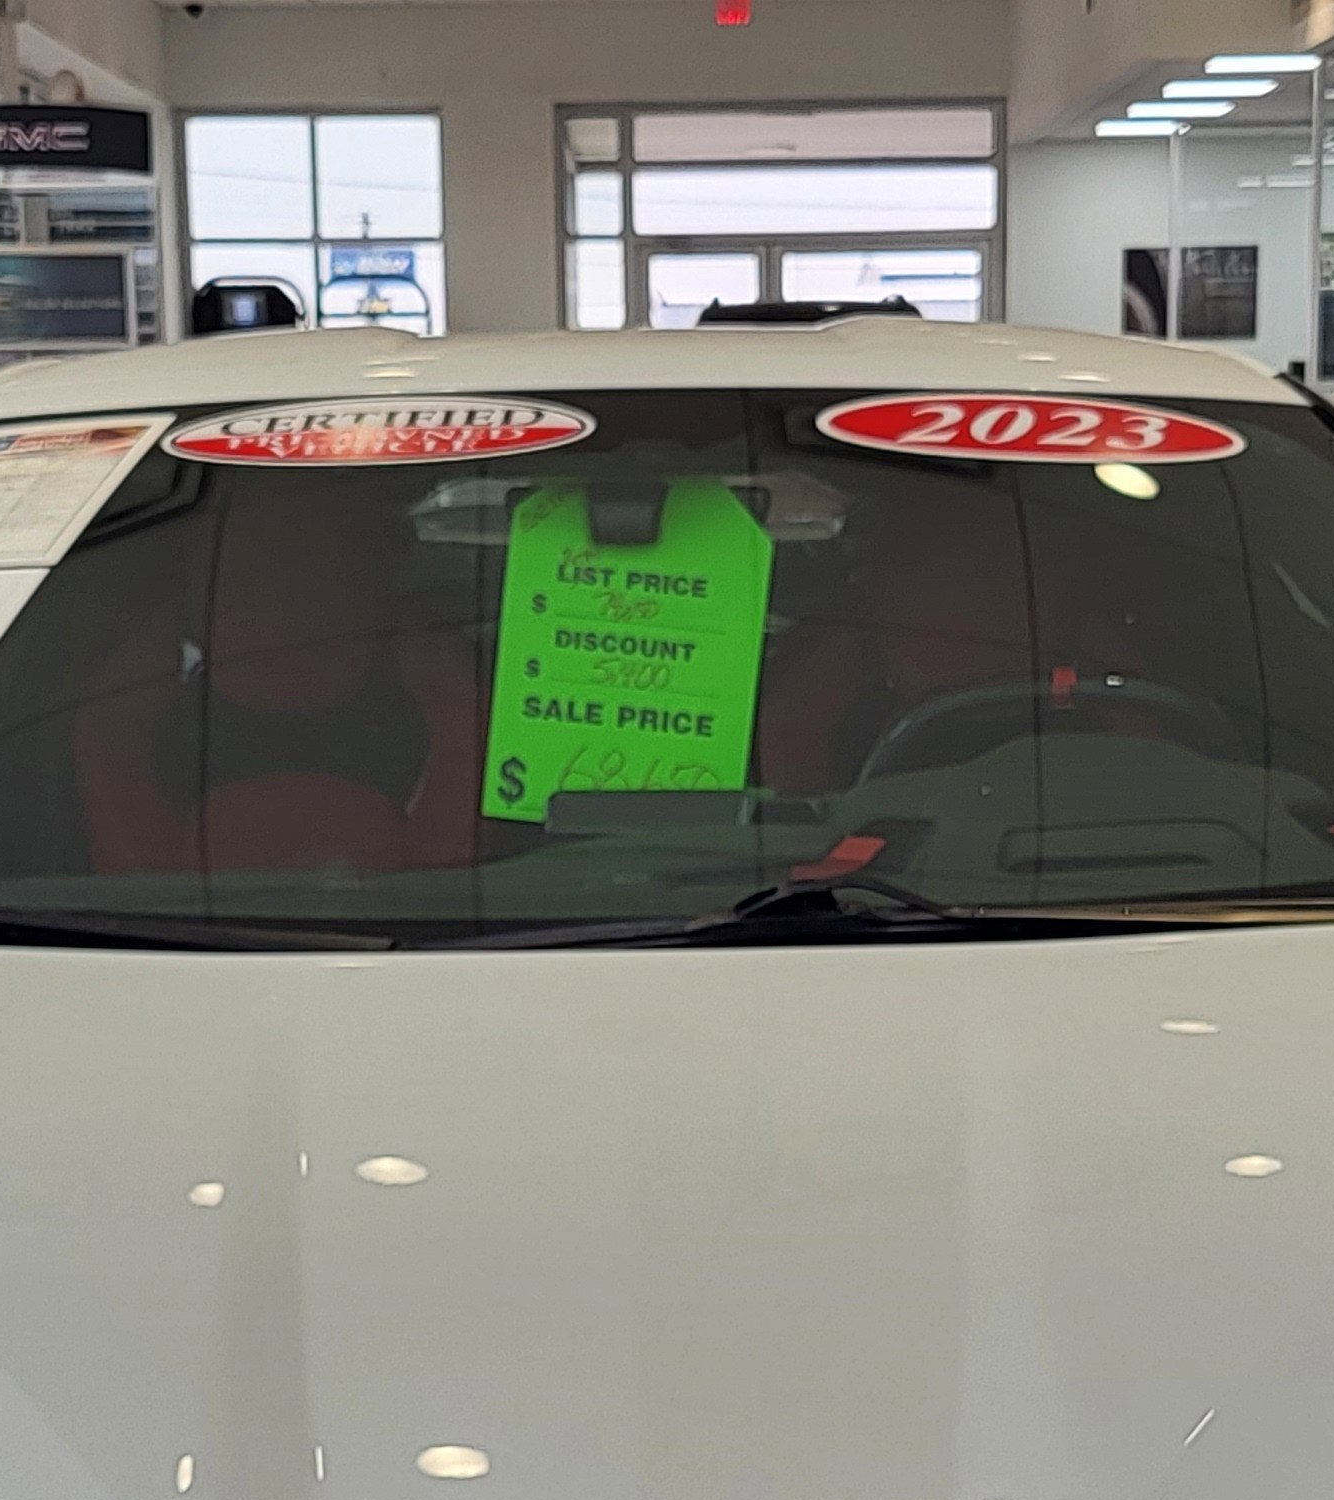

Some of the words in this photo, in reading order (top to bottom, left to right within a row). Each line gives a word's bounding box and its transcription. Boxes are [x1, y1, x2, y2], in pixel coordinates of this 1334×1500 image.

[220, 409, 545, 435] CERTIFIED
[897, 403, 1170, 450] 2023
[557, 565, 615, 588] LIST
[625, 571, 709, 599] PRICE
[531, 593, 548, 614] $
[554, 629, 696, 664] DISCOUNT
[524, 657, 540, 678] $
[522, 695, 604, 726] SALE
[617, 705, 715, 738] PRICE
[497, 755, 527, 809] $
